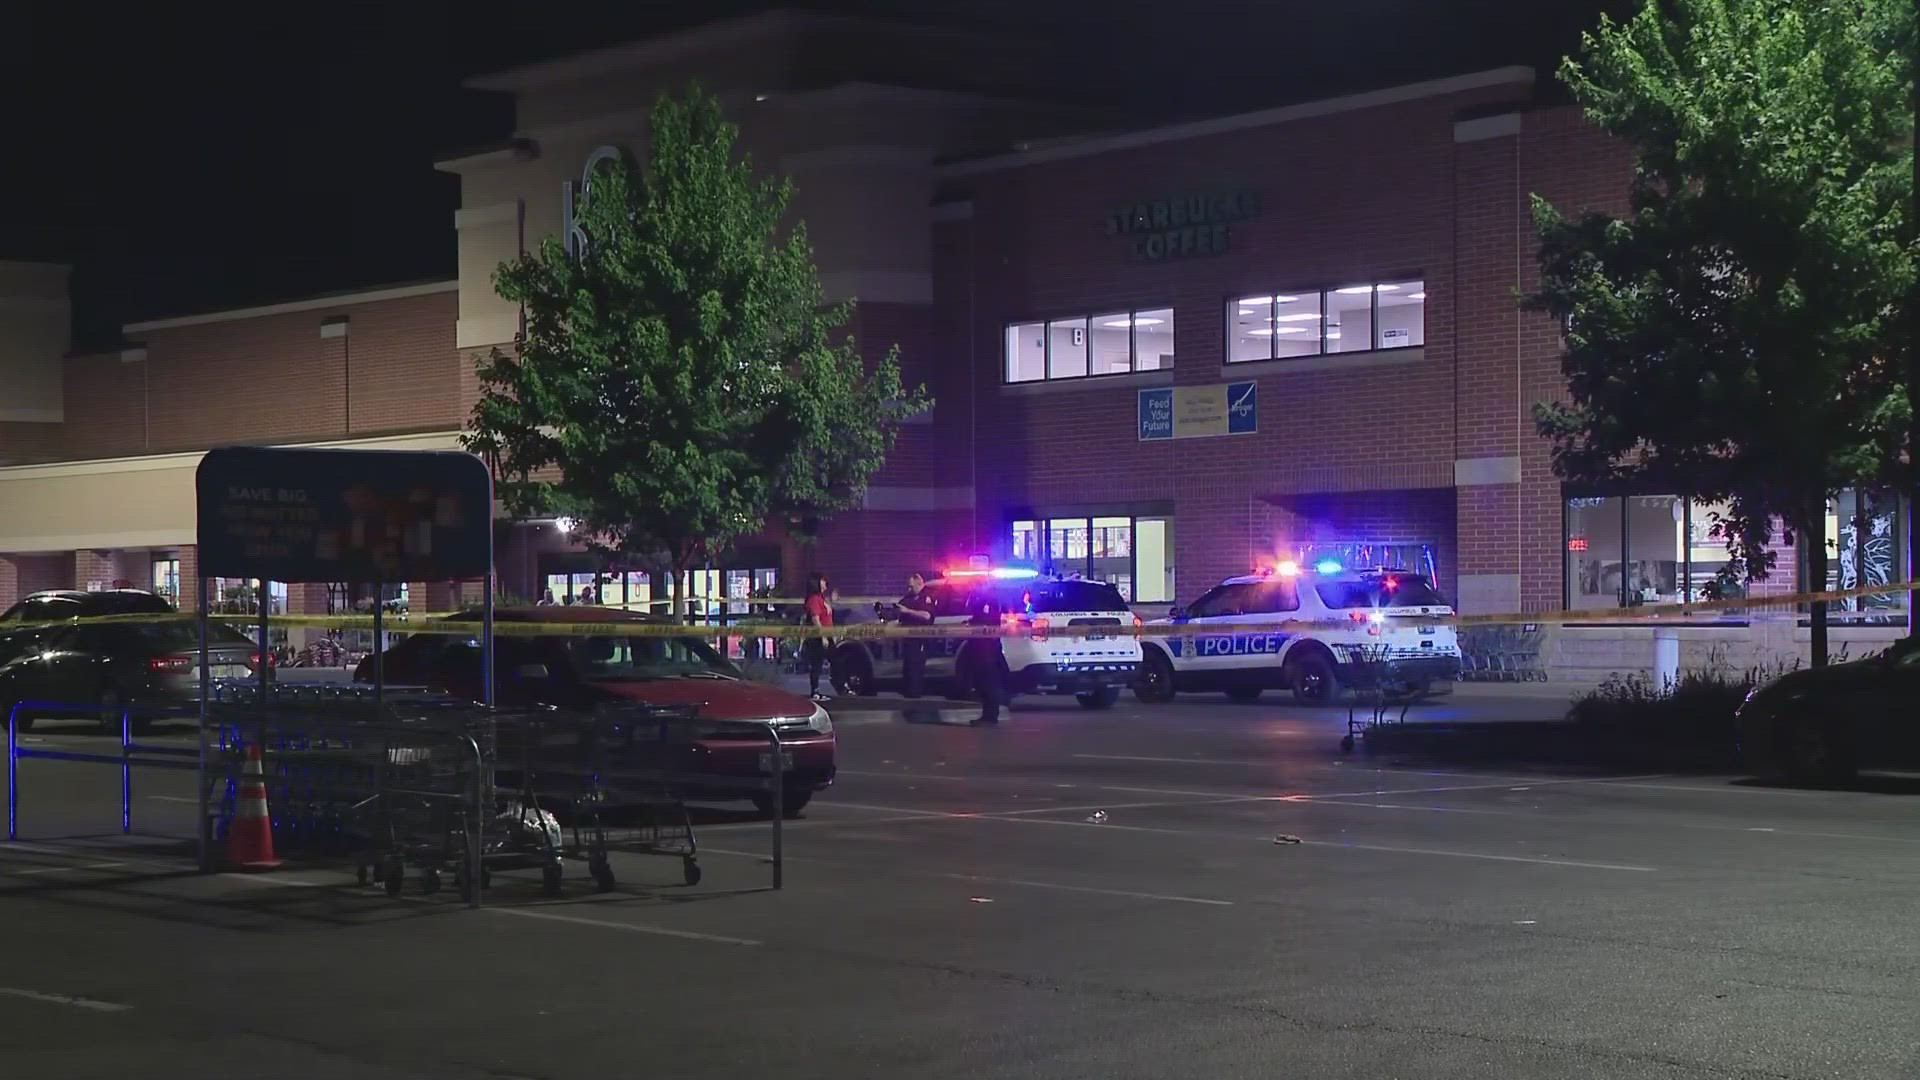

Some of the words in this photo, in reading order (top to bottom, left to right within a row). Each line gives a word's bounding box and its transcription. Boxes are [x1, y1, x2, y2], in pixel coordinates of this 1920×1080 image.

[1131, 220, 1230, 260] COFFEE
[1149, 399, 1170, 409] Feed
[1151, 409, 1170, 420] Your
[1142, 420, 1170, 431] Future
[1204, 634, 1278, 656] POLICE
